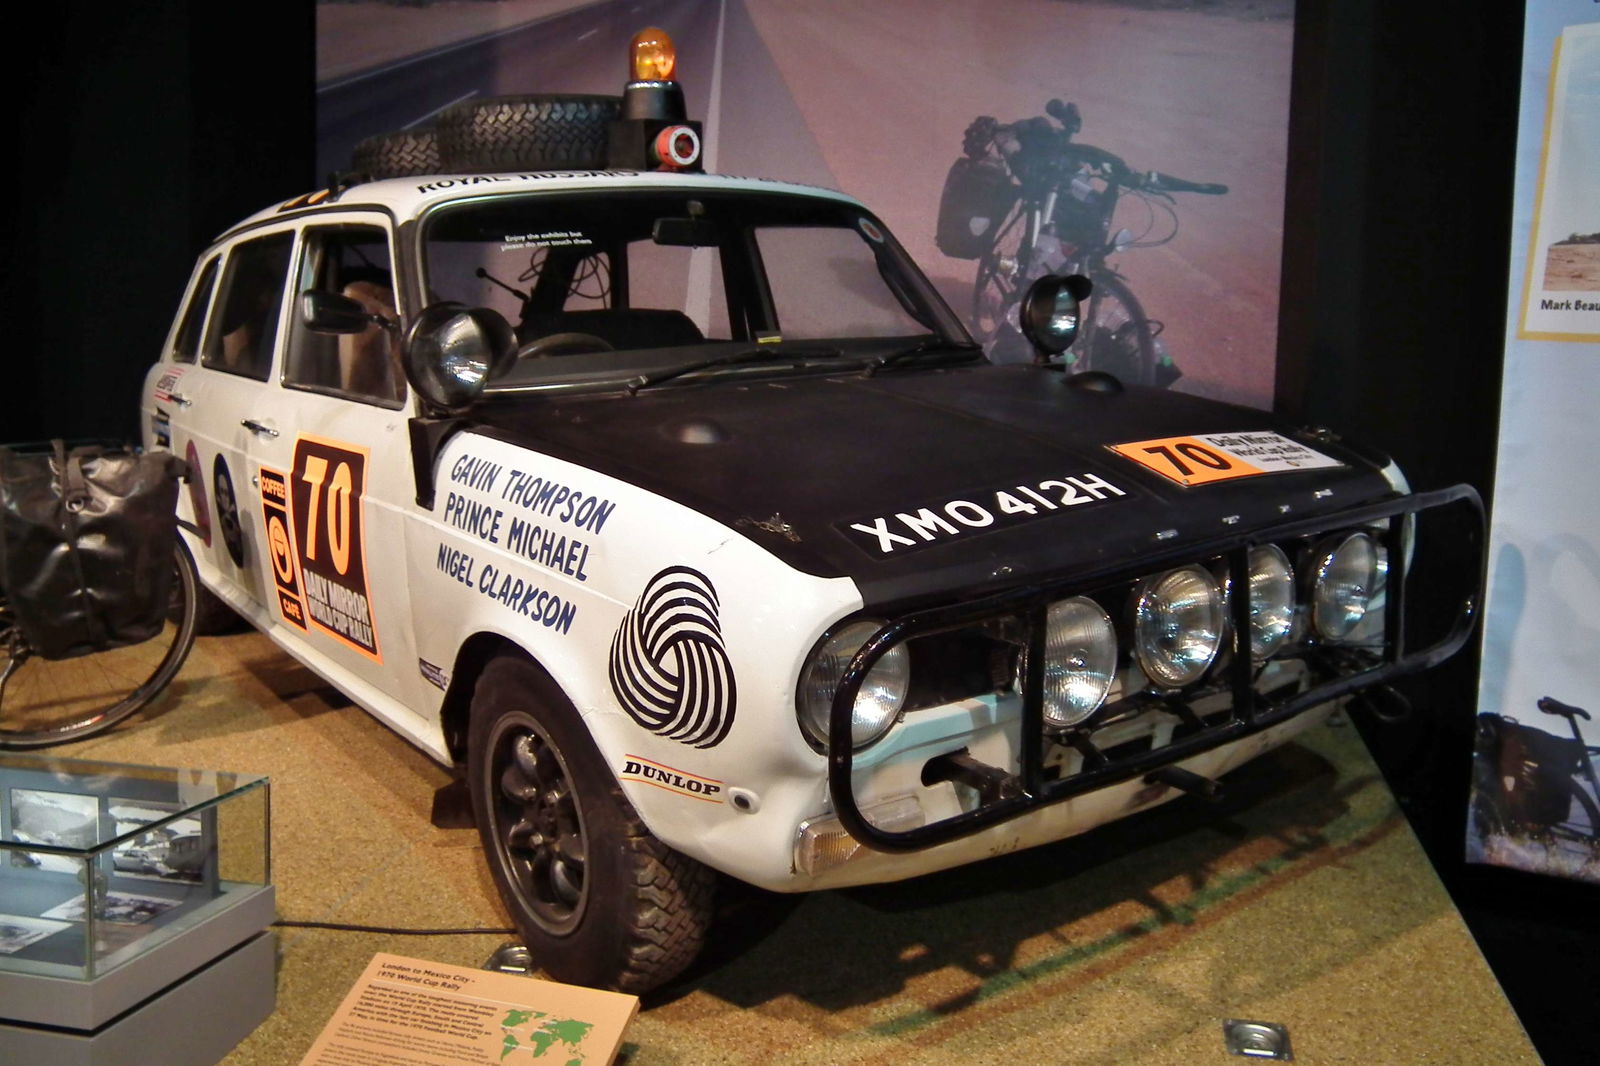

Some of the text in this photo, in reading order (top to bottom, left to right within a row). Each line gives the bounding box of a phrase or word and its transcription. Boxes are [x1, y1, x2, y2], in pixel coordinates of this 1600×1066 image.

[416, 175, 511, 194] ROYAL
[500, 243, 524, 252] please
[1541, 299, 1600, 312] Mark Beau
[1142, 443, 1232, 476] 70
[261, 476, 286, 500] COFFEE
[451, 454, 616, 535] GAVIN THOMPSON
[302, 455, 352, 576] 70
[850, 473, 1127, 553] XMO 412H
[444, 492, 590, 582] PRINCE MICHAEL
[436, 542, 577, 636] NIGEL CLARKSON
[622, 761, 720, 796] DUNLOP
[377, 970, 460, 991] 1970 World Cup Rally
[382, 962, 411, 972] London
[424, 970, 452, 980] Mexico
[453, 974, 470, 984] City
